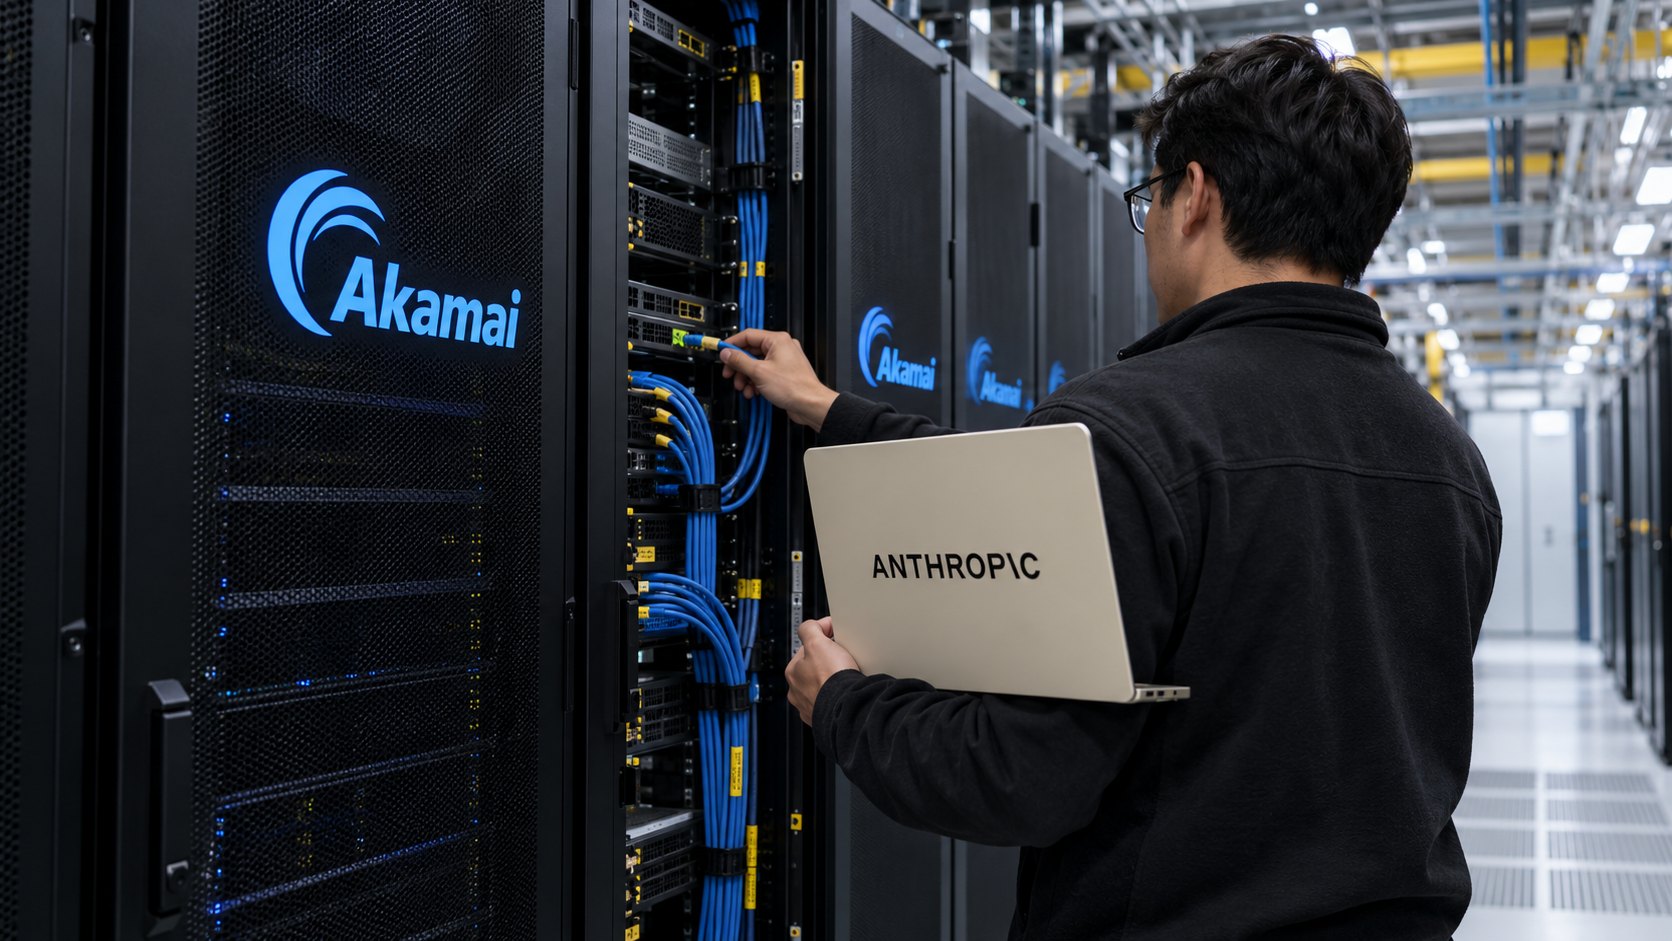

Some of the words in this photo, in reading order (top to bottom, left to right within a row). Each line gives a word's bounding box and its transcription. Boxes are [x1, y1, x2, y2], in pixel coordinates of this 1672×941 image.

[329, 256, 522, 349] Akamai
[875, 345, 937, 391] Akamai
[979, 370, 1022, 409] Akamai
[872, 552, 1041, 580] ANTHROPIC
